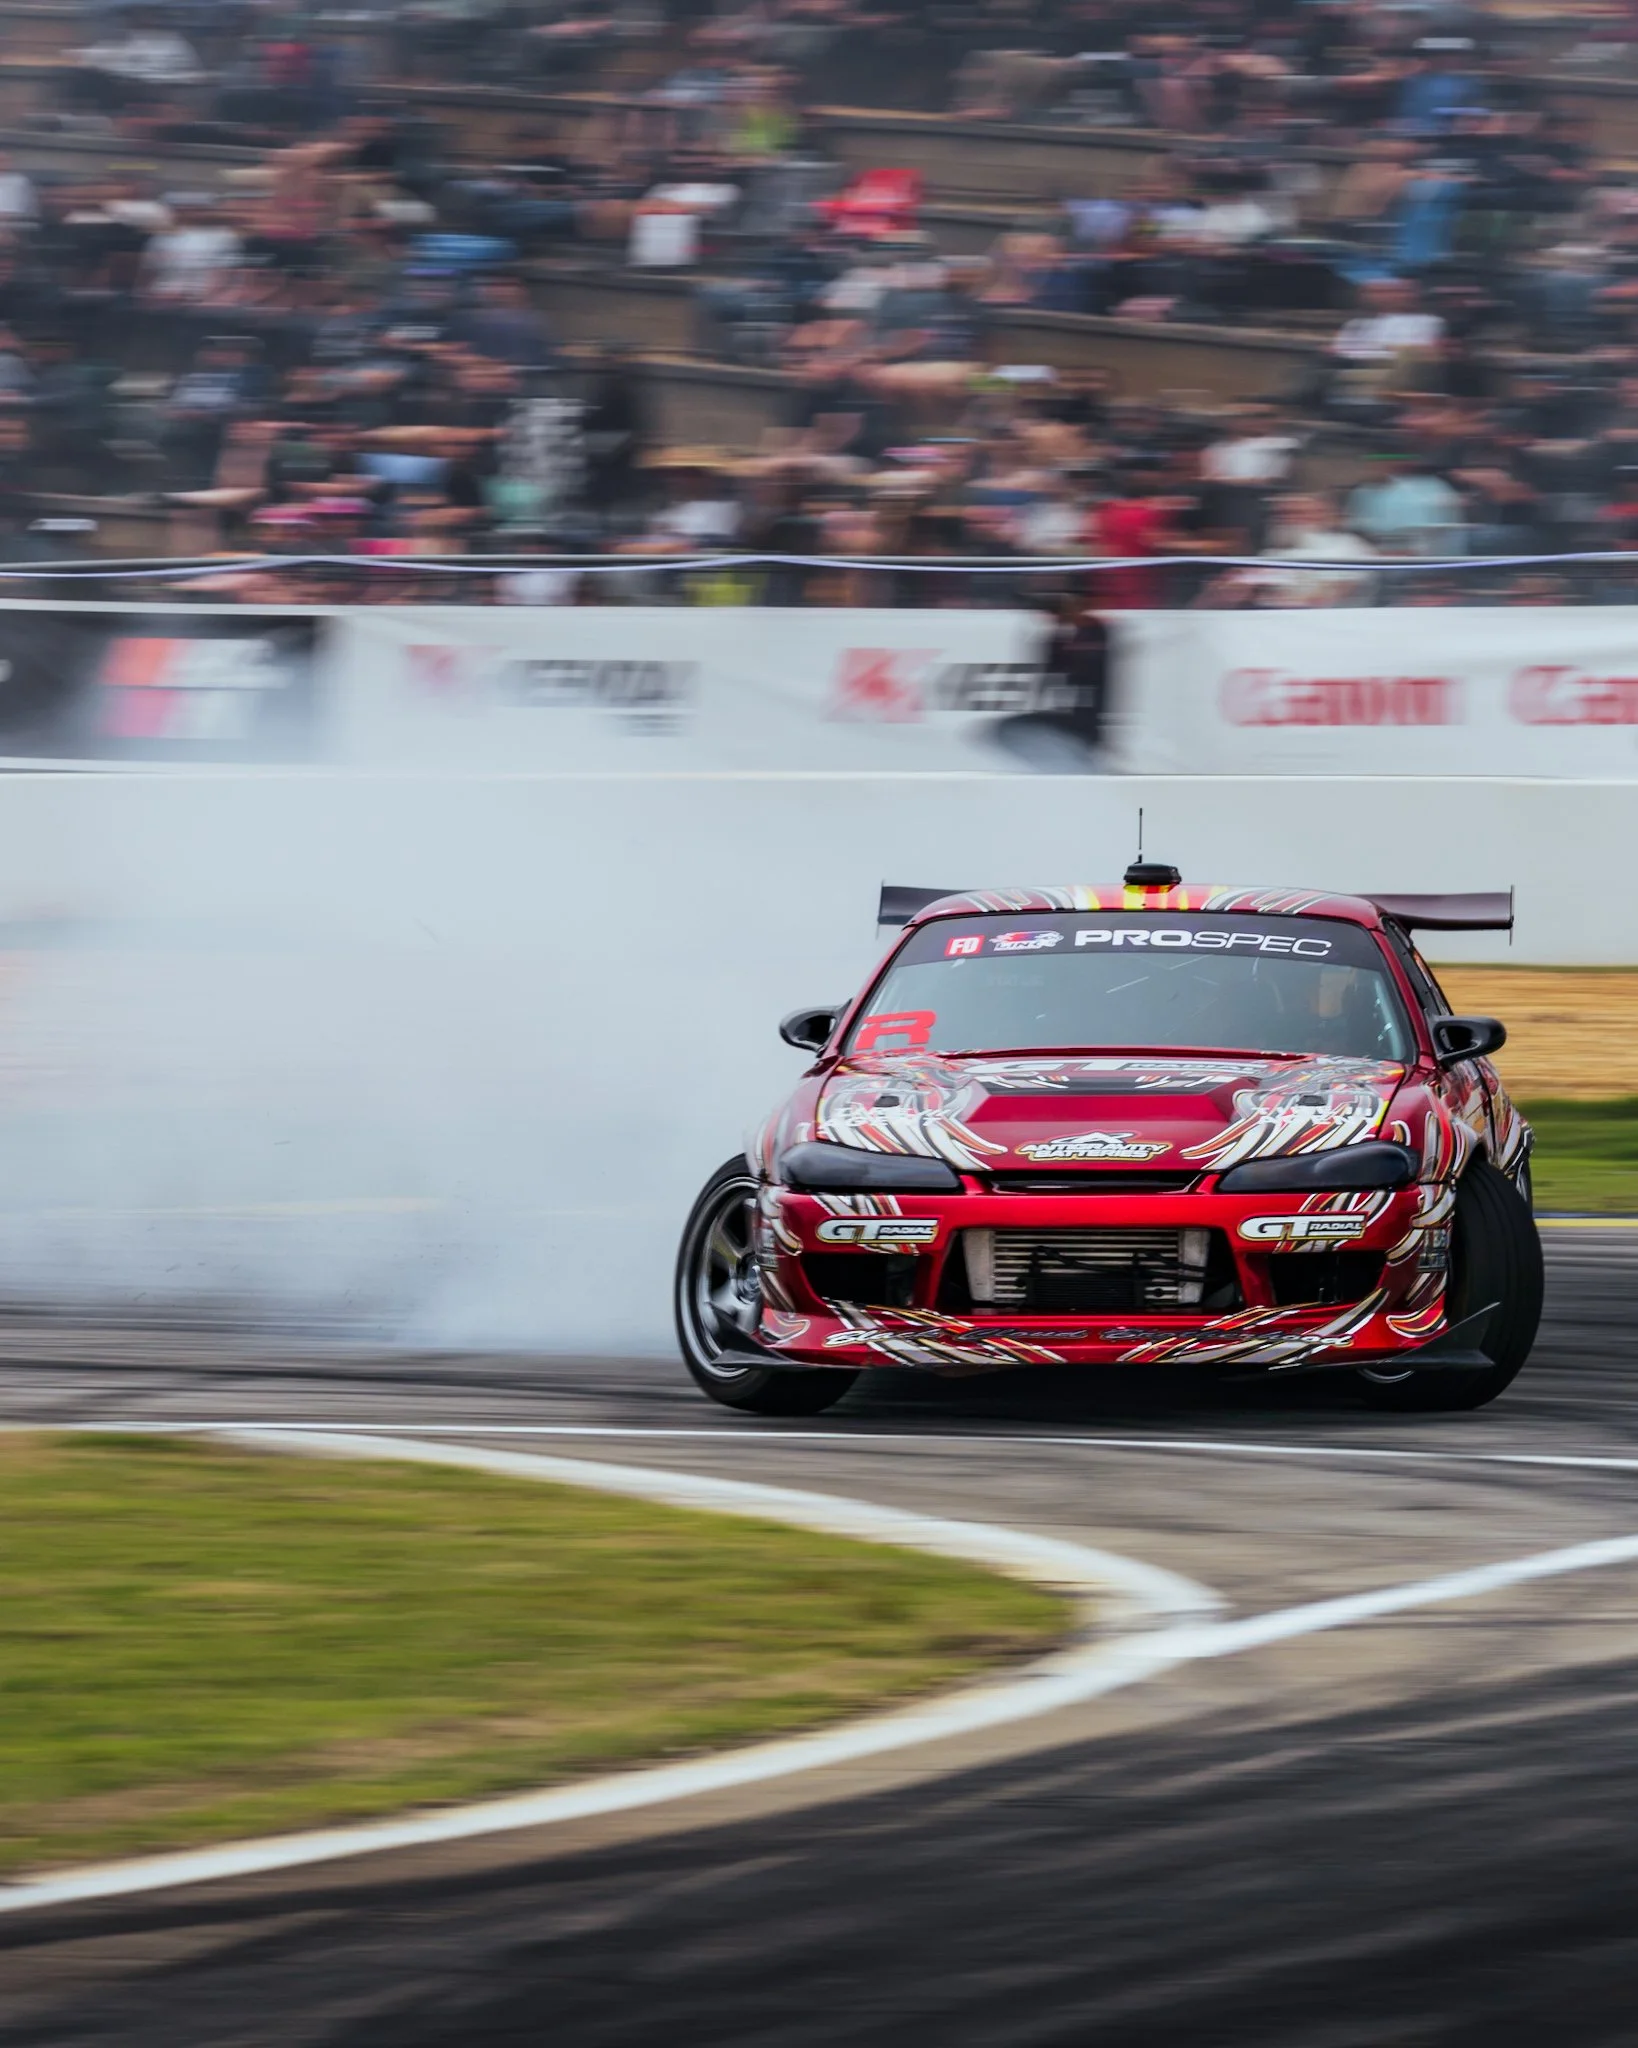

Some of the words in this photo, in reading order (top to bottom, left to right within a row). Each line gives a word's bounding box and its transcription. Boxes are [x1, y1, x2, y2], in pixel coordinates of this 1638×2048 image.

[1217, 667, 1466, 726] Canon
[949, 937, 980, 955] FD
[855, 1009, 937, 1050] R
[817, 1219, 882, 1241] GT
[879, 1226, 934, 1234] RADIAL
[1240, 1215, 1310, 1238] GT
[1309, 1222, 1363, 1230] RADIAL
